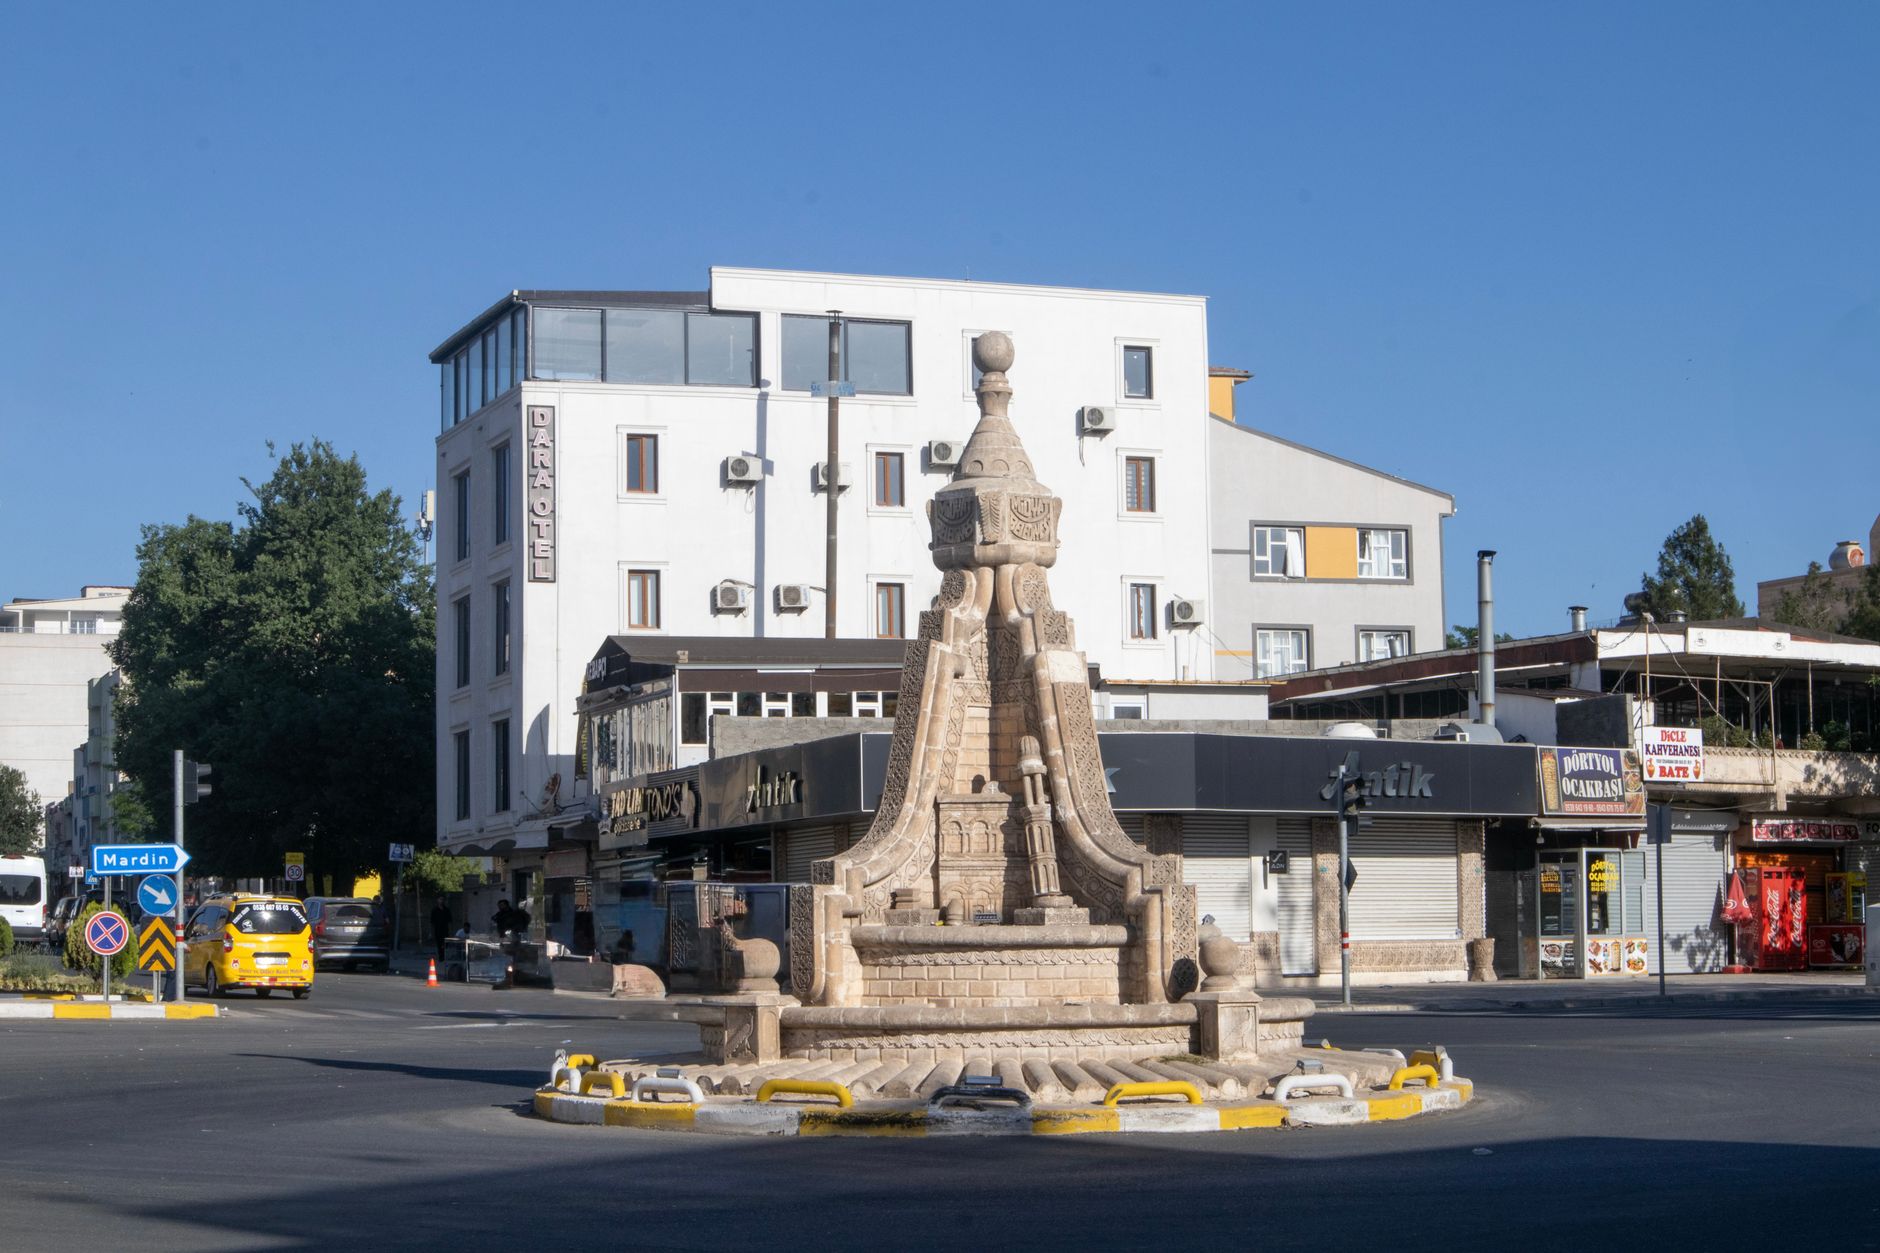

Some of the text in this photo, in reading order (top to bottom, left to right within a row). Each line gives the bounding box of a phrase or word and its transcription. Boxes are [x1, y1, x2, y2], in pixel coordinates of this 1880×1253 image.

[532, 408, 552, 579] DARA OTEL
[1320, 751, 1435, 800] Antik
[1563, 750, 1618, 776] DÖRTYOL
[1659, 766, 1689, 778] BATE
[746, 765, 797, 813] Antik
[1562, 777, 1623, 801] OCAKBAŞI
[103, 853, 169, 866] Mardin
[290, 868, 300, 877] 30
